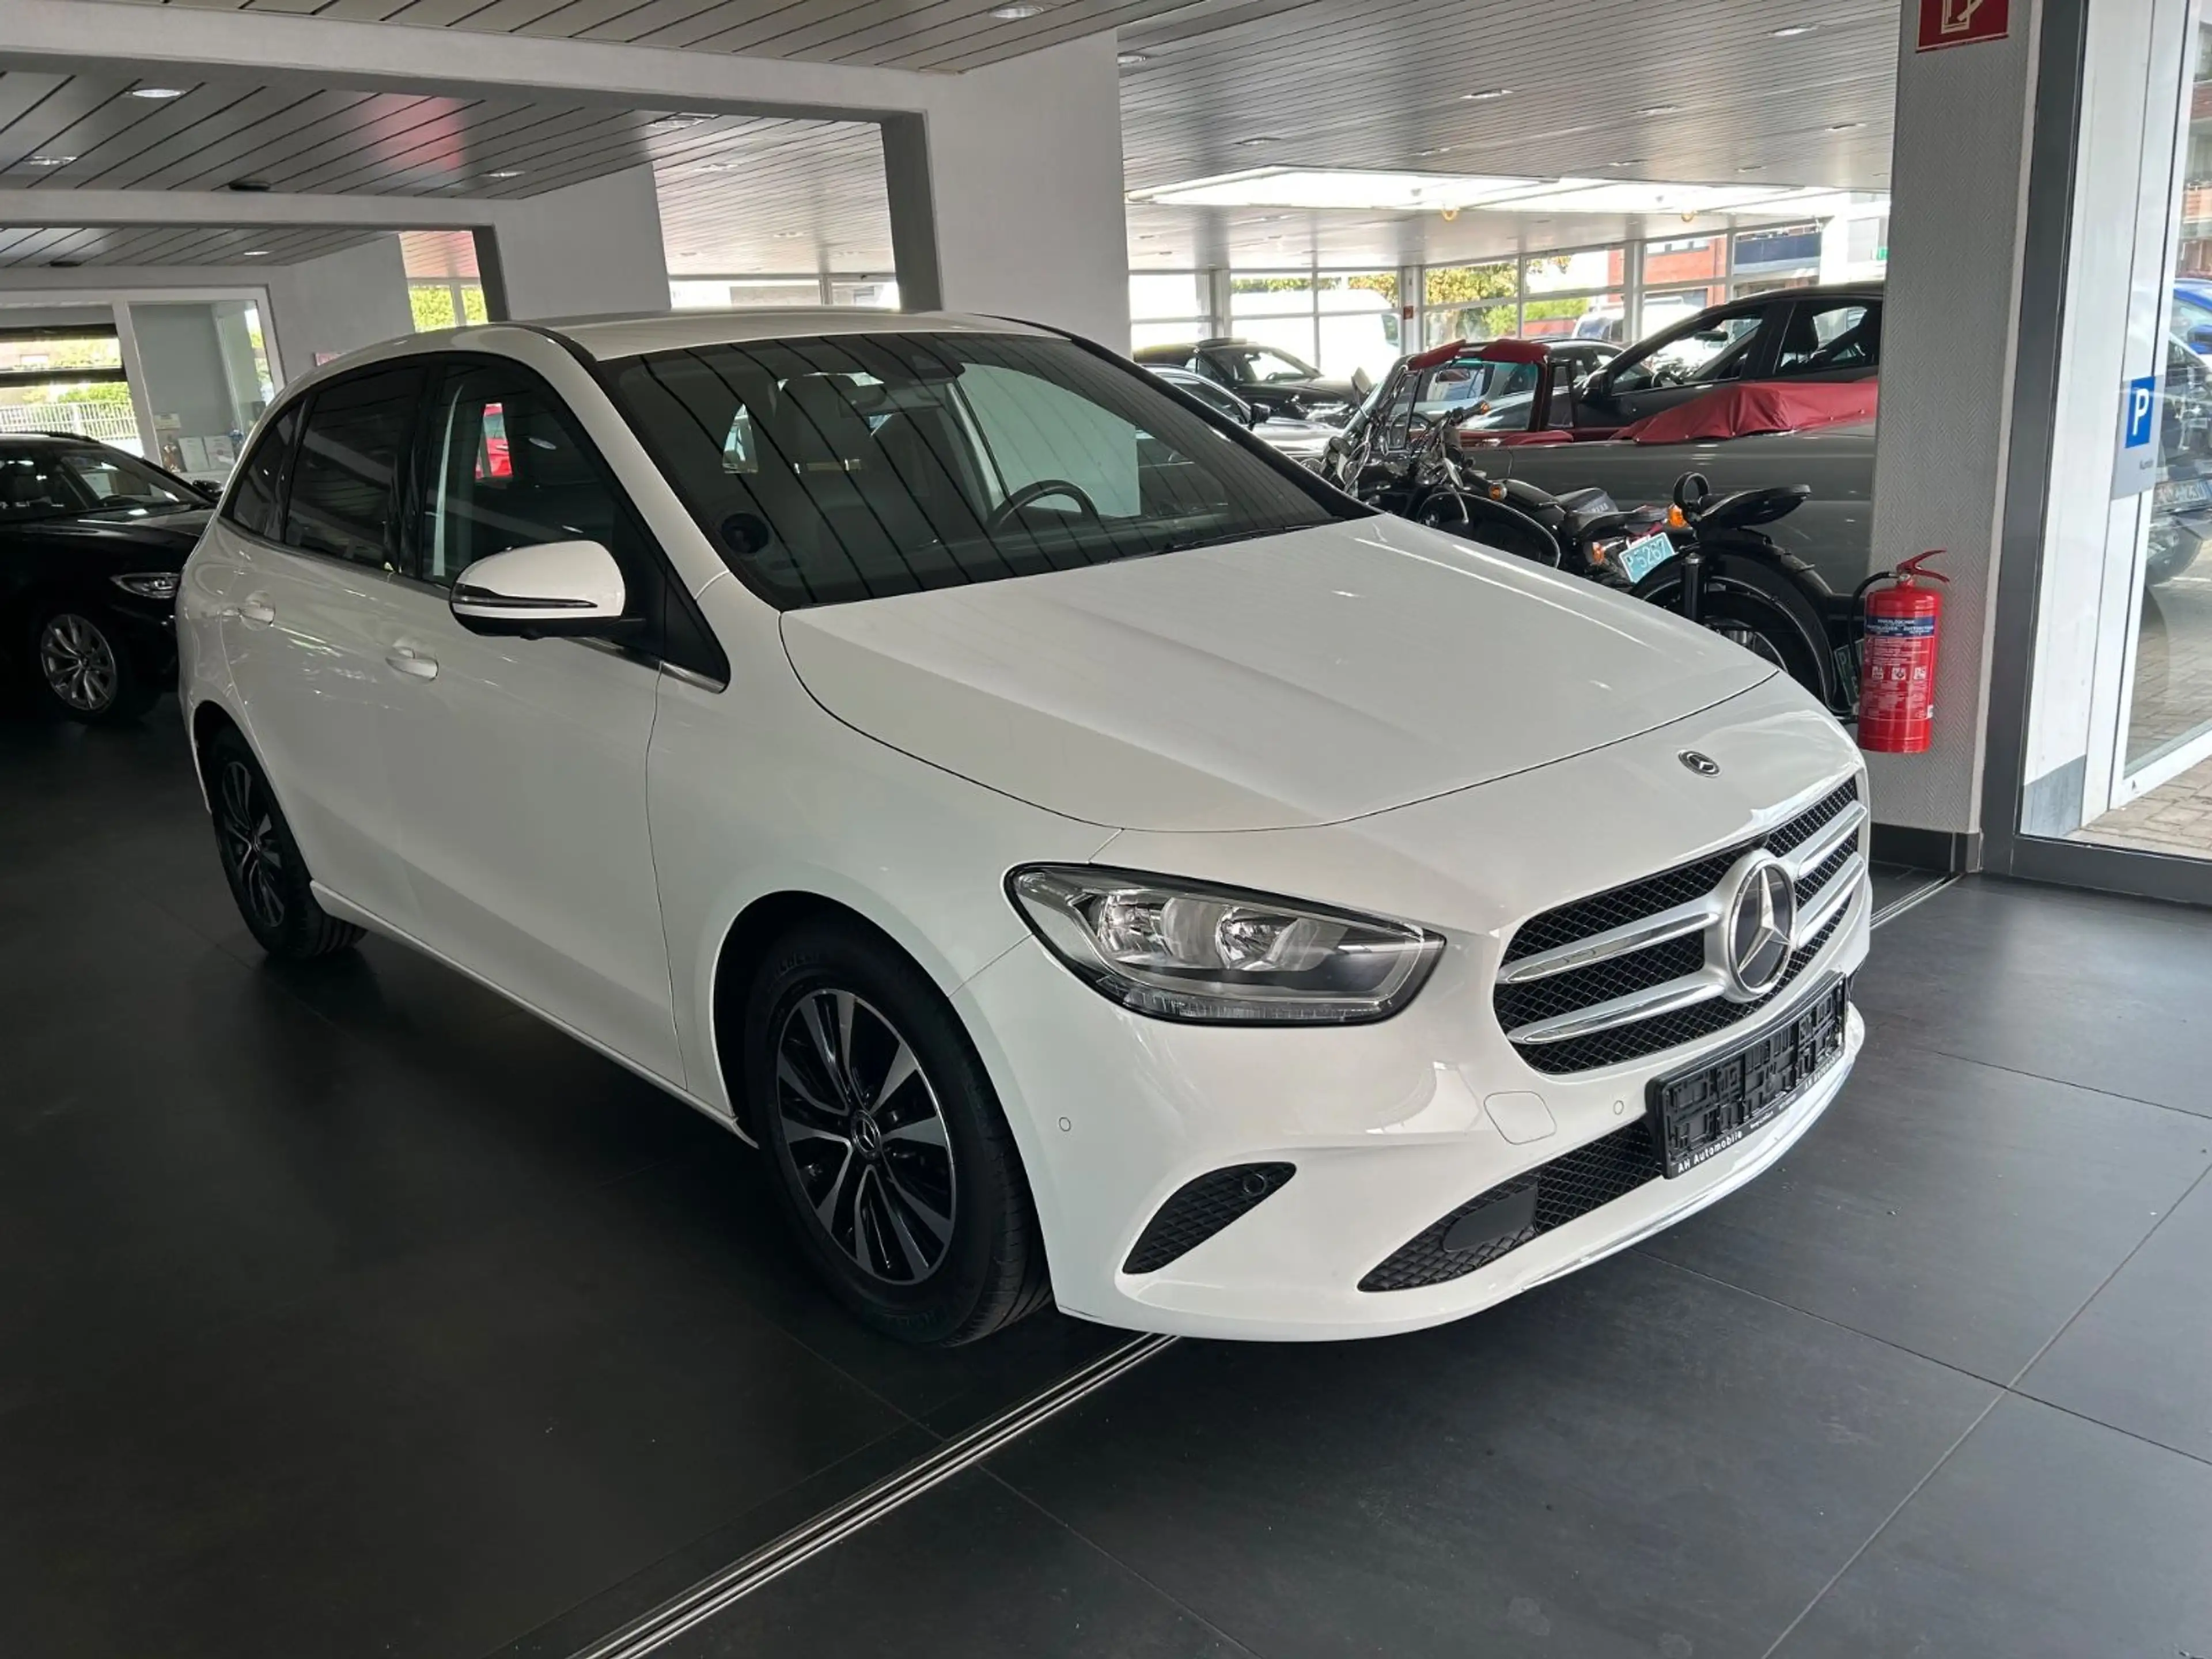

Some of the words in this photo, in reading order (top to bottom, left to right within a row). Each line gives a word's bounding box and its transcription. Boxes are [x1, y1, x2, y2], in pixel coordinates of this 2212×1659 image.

[2133, 388, 2149, 436] P
[1634, 538, 1666, 568] 5267
[1678, 1158, 1691, 1173] AH
[1694, 1131, 1743, 1165] Automobile
